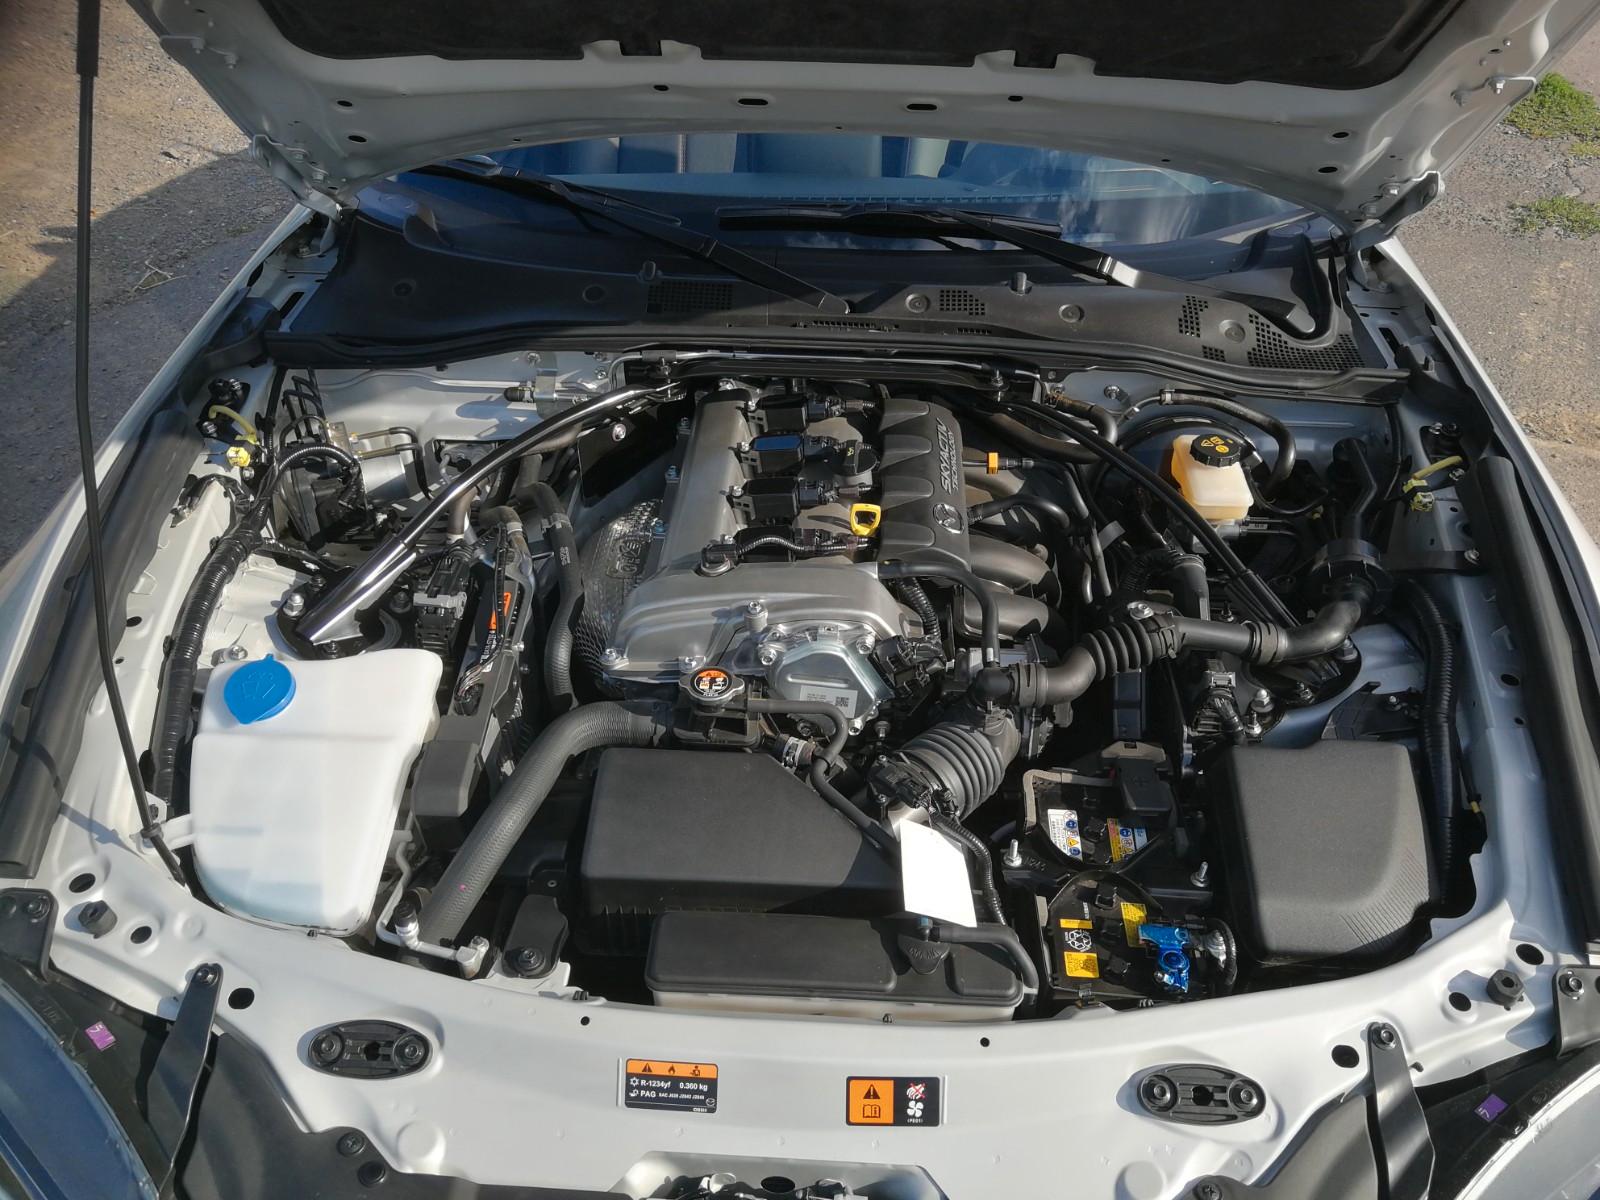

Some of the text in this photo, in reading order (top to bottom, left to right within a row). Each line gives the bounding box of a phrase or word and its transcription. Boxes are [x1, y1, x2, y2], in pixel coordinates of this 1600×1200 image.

[937, 417, 952, 495] SKYACTIV
[640, 1079, 671, 1089] R-1234yf
[698, 1083, 708, 1092] kg
[640, 1090, 656, 1098] PAG
